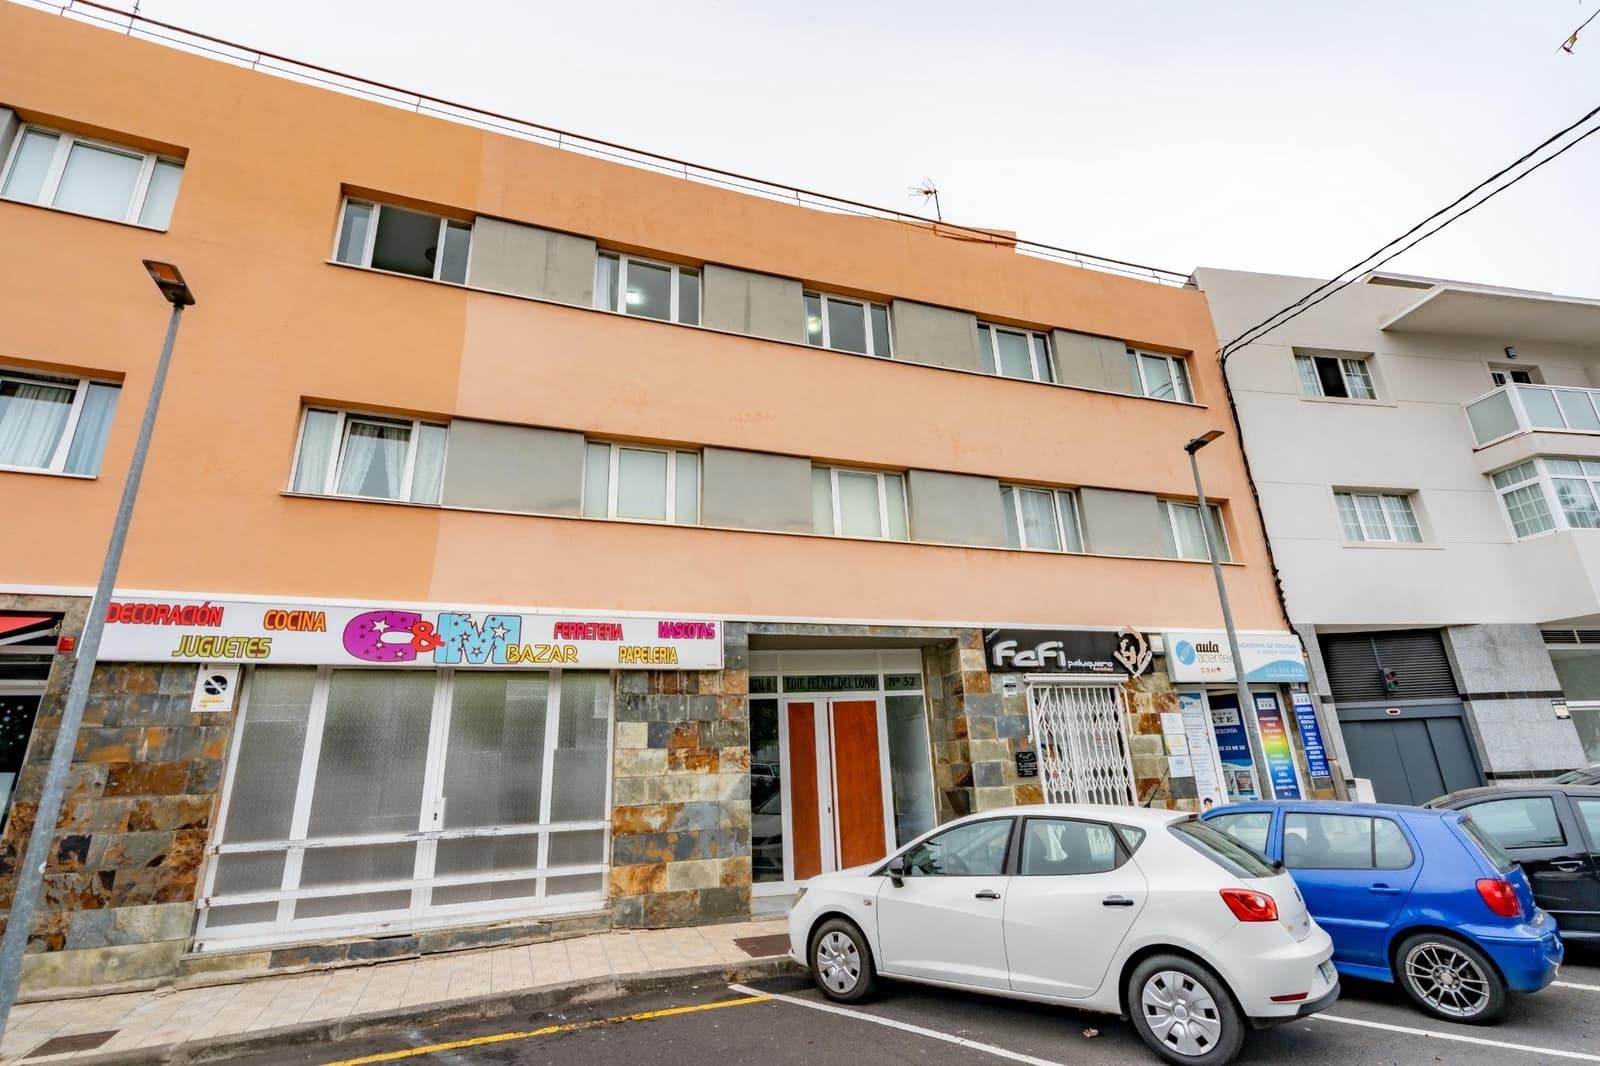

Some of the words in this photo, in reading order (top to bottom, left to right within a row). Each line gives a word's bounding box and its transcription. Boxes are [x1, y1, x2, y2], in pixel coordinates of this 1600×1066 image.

[105, 601, 224, 627] DECORACIÓN
[263, 609, 327, 632] COCINA
[553, 621, 624, 641] FERRETERIA
[658, 621, 715, 640] MASCOTAS
[172, 635, 272, 658] JUGUETES
[505, 644, 578, 664] BAZAR
[618, 645, 678, 664] PAPELERIA
[1195, 640, 1220, 653] aula
[855, 676, 876, 688] LOMO
[903, 677, 915, 686] 32
